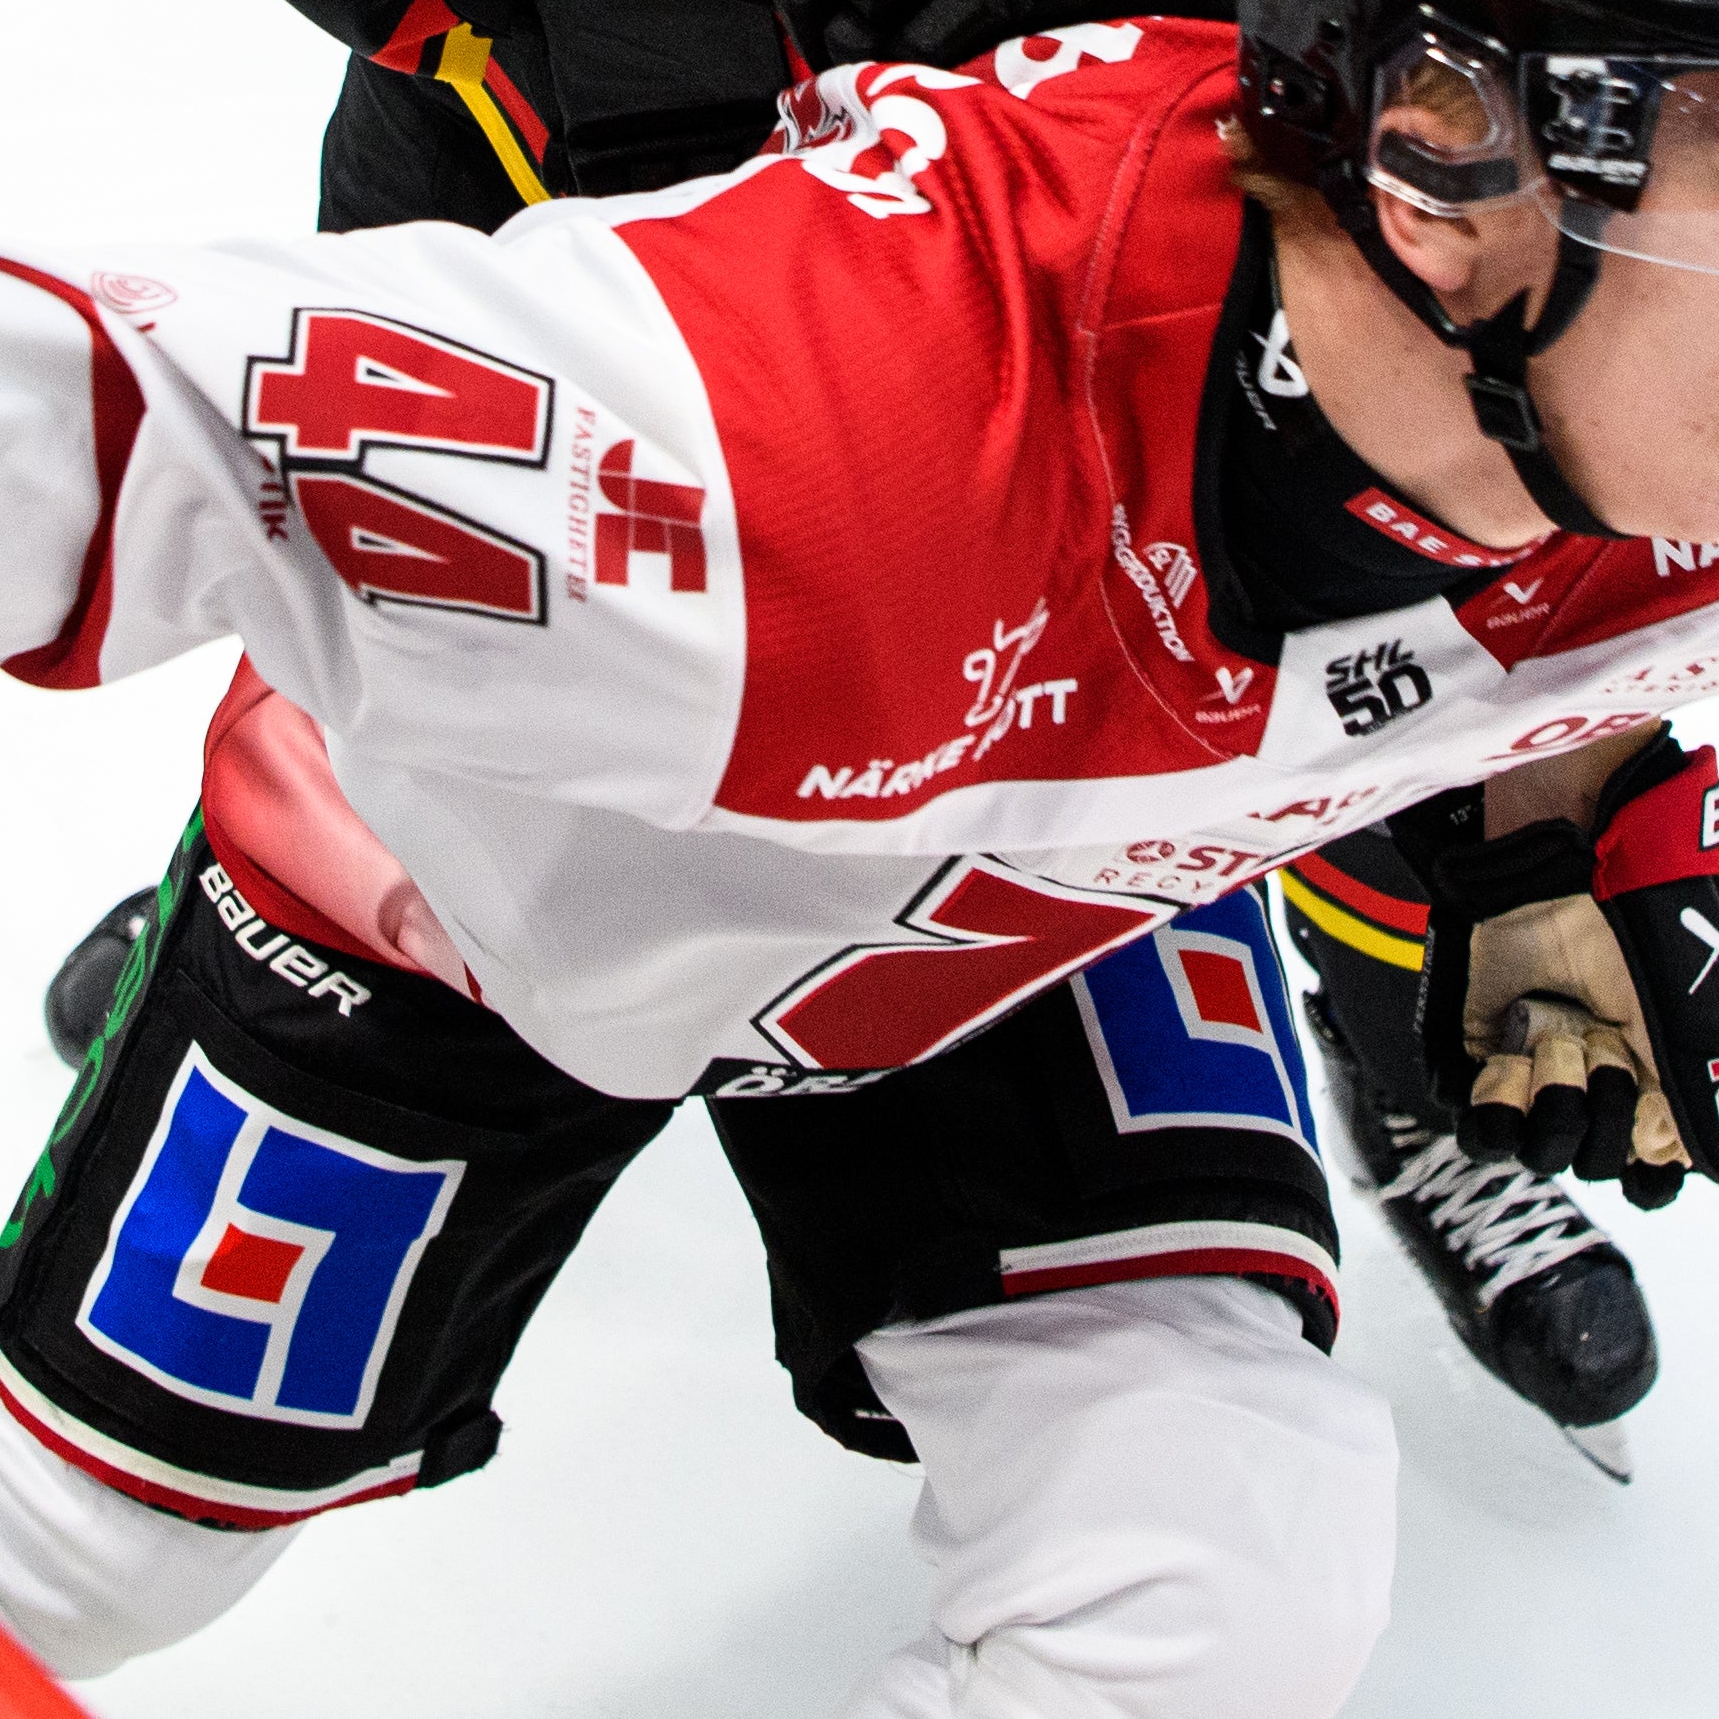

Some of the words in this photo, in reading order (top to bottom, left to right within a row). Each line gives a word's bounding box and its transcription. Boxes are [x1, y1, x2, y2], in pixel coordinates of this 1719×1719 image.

[241, 307, 556, 627] 44
[1365, 491, 1450, 554] BAE
[1326, 638, 1415, 683] SHL
[1326, 665, 1434, 738] 50
[198, 863, 372, 1017] BAUER
